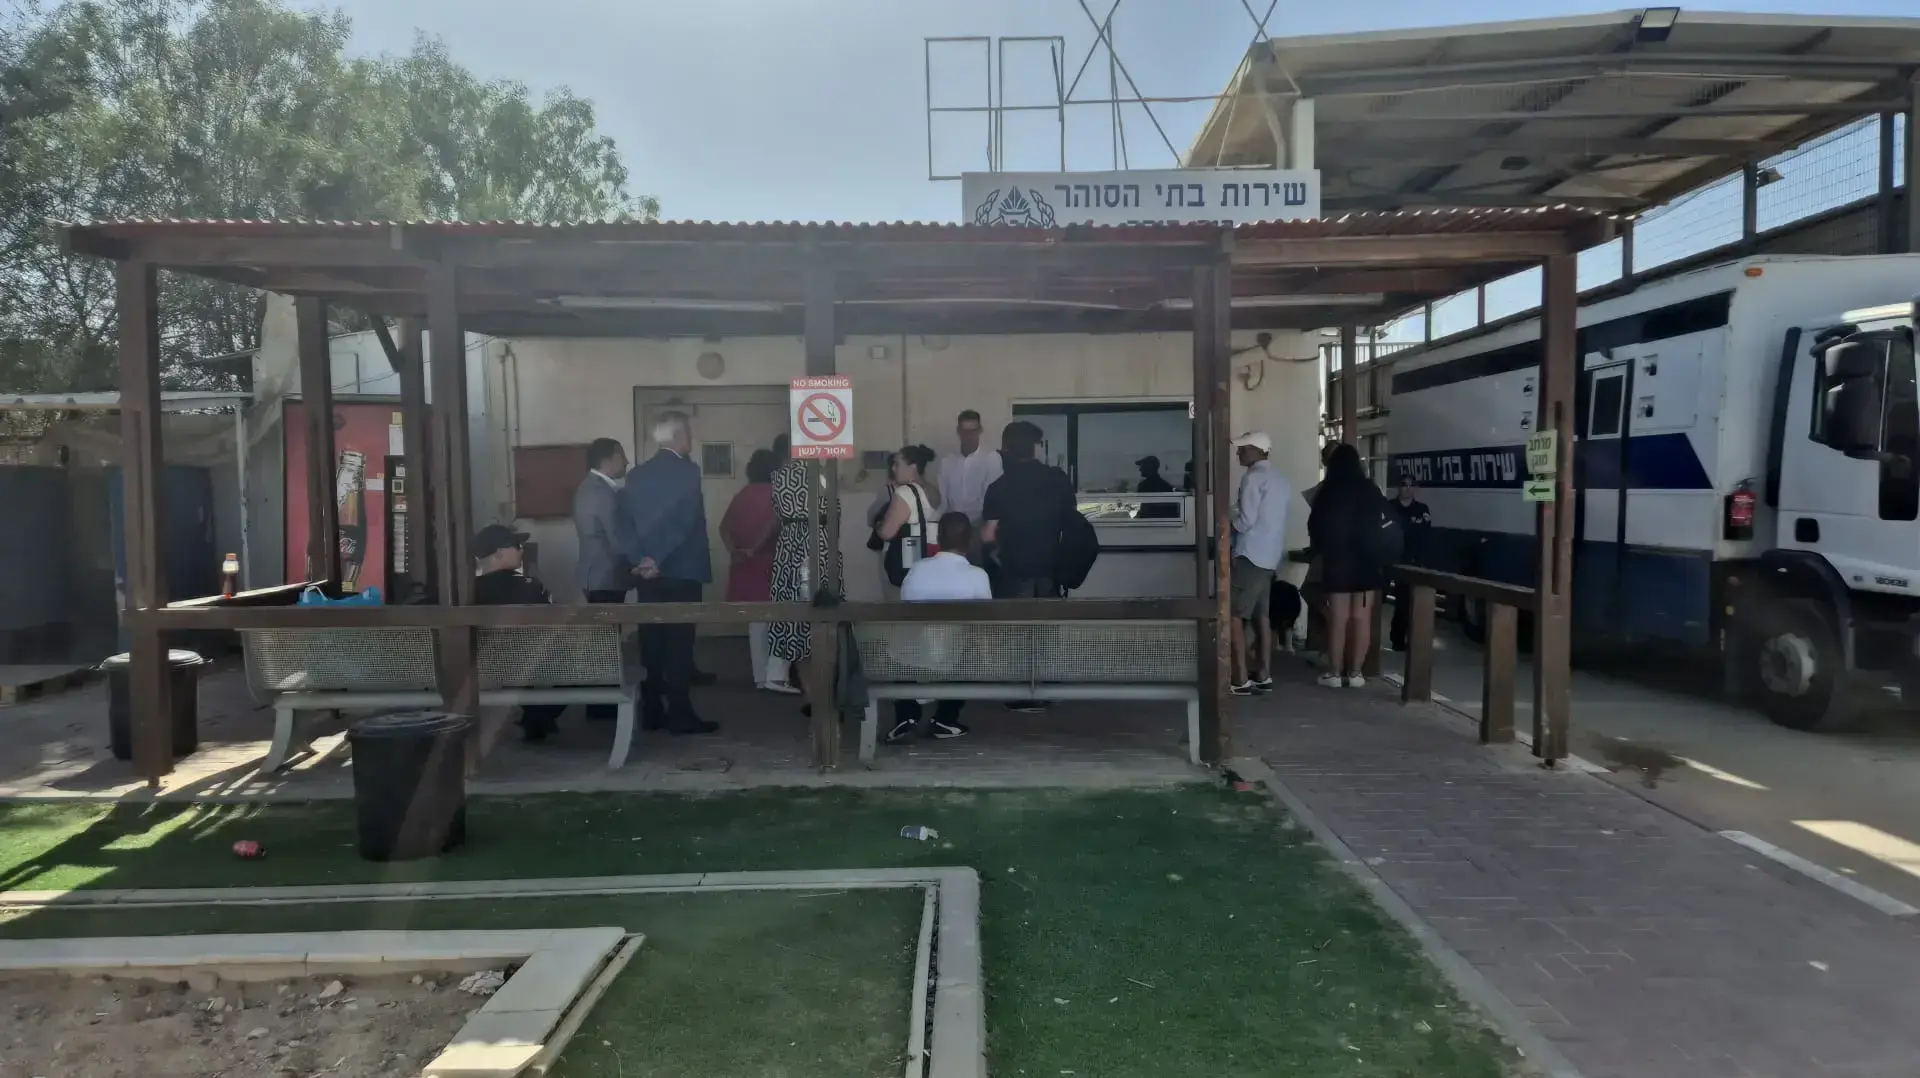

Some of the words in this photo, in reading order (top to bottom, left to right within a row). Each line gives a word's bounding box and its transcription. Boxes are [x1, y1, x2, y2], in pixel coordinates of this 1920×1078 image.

[1054, 184, 1140, 208] הסוהר
[1155, 184, 1205, 208] בתי
[1220, 183, 1306, 207] שירות
[793, 379, 806, 387] NO
[808, 379, 849, 387] SMOKING
[798, 446, 821, 456] לעשן
[824, 447, 846, 455] אסור
[1437, 456, 1464, 481] בתי
[1470, 453, 1516, 481] שירות
